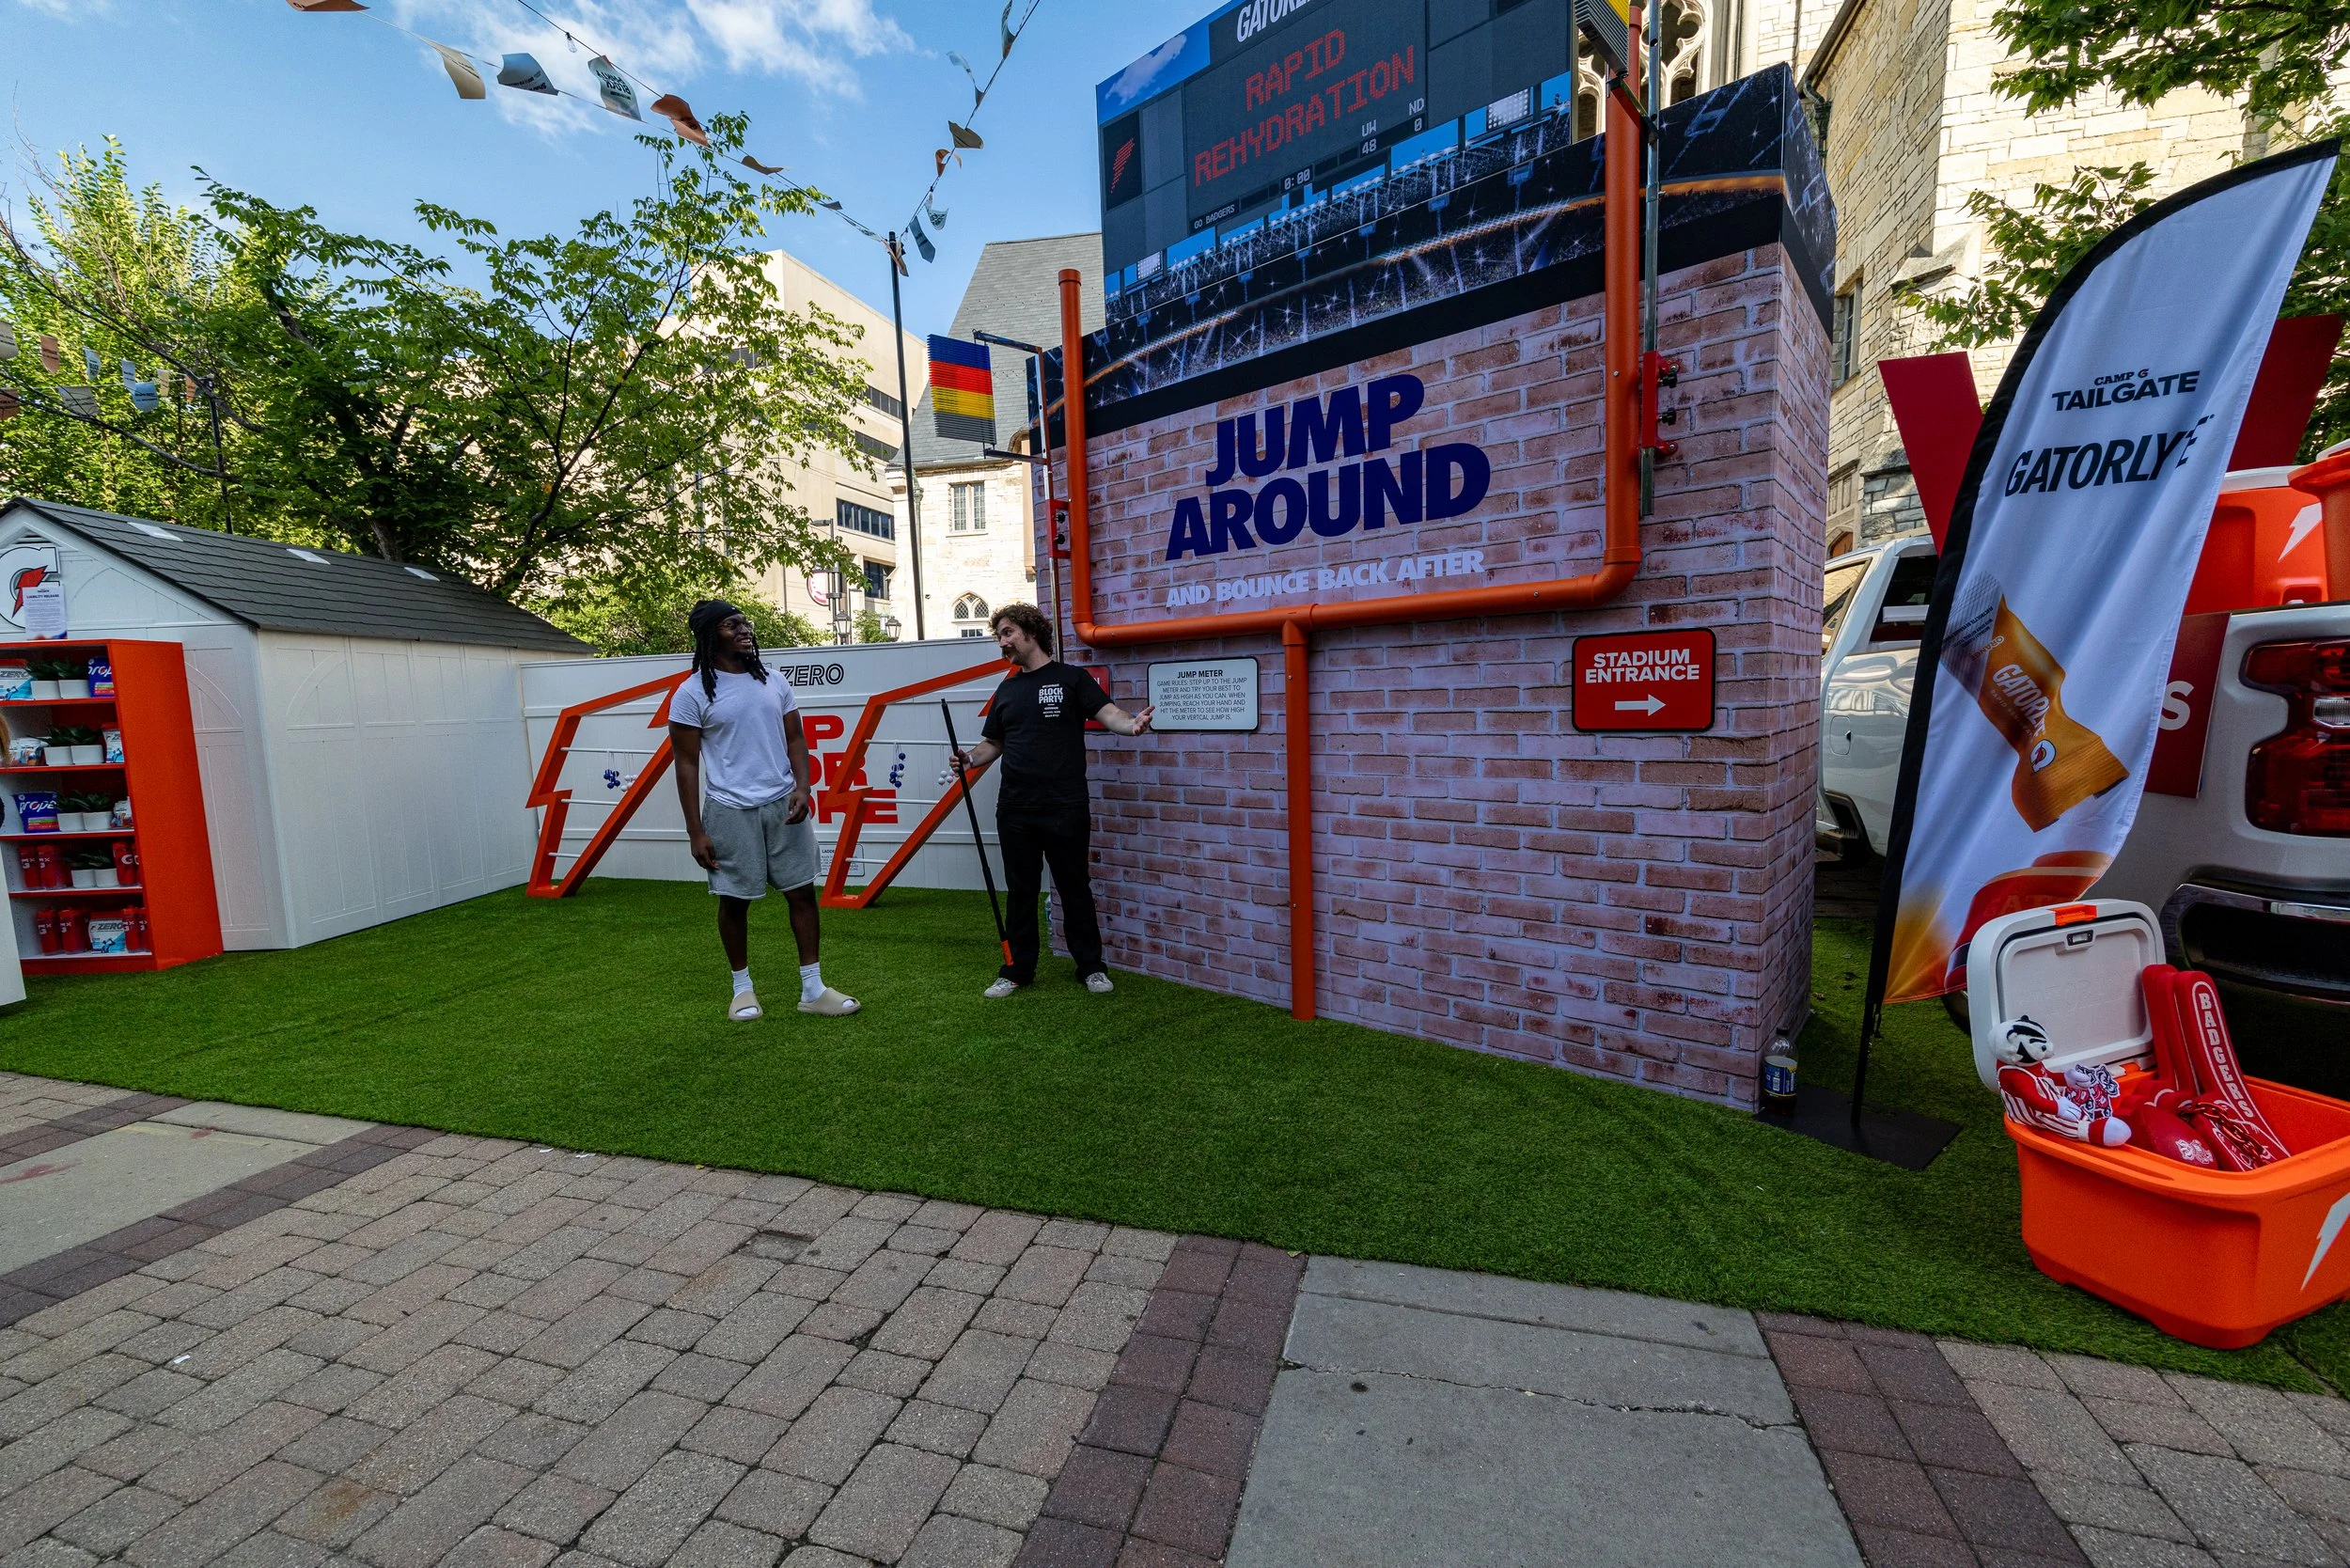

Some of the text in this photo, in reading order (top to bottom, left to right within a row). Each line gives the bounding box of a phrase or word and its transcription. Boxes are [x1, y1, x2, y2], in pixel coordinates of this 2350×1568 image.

[1246, 28, 1345, 112] RAPID
[1195, 45, 1414, 186] REHYDRATION
[1409, 98, 1424, 116] ND
[1362, 119, 1377, 137] UW
[1414, 118, 1422, 132] 0
[1362, 138, 1377, 155] 48
[1194, 204, 1235, 229] GO BADGERS
[2094, 371, 2135, 386] CAMP
[2051, 370, 2201, 412] TAILGATE
[1205, 374, 1425, 487] JUMP
[1165, 442, 1491, 561] AROUND
[1166, 550, 1485, 607] AND BOUNCE BACK AFTER
[1593, 649, 1690, 667] STADIUM
[780, 663, 844, 687] ZERO
[1178, 669, 1223, 679] JUMP METER
[1585, 665, 1700, 683] ENTRANCE
[1039, 687, 1063, 697] BLOCK
[1039, 695, 1063, 704] PARTY
[2159, 681, 2194, 730] S
[2199, 993, 2254, 1118] BADGERS
